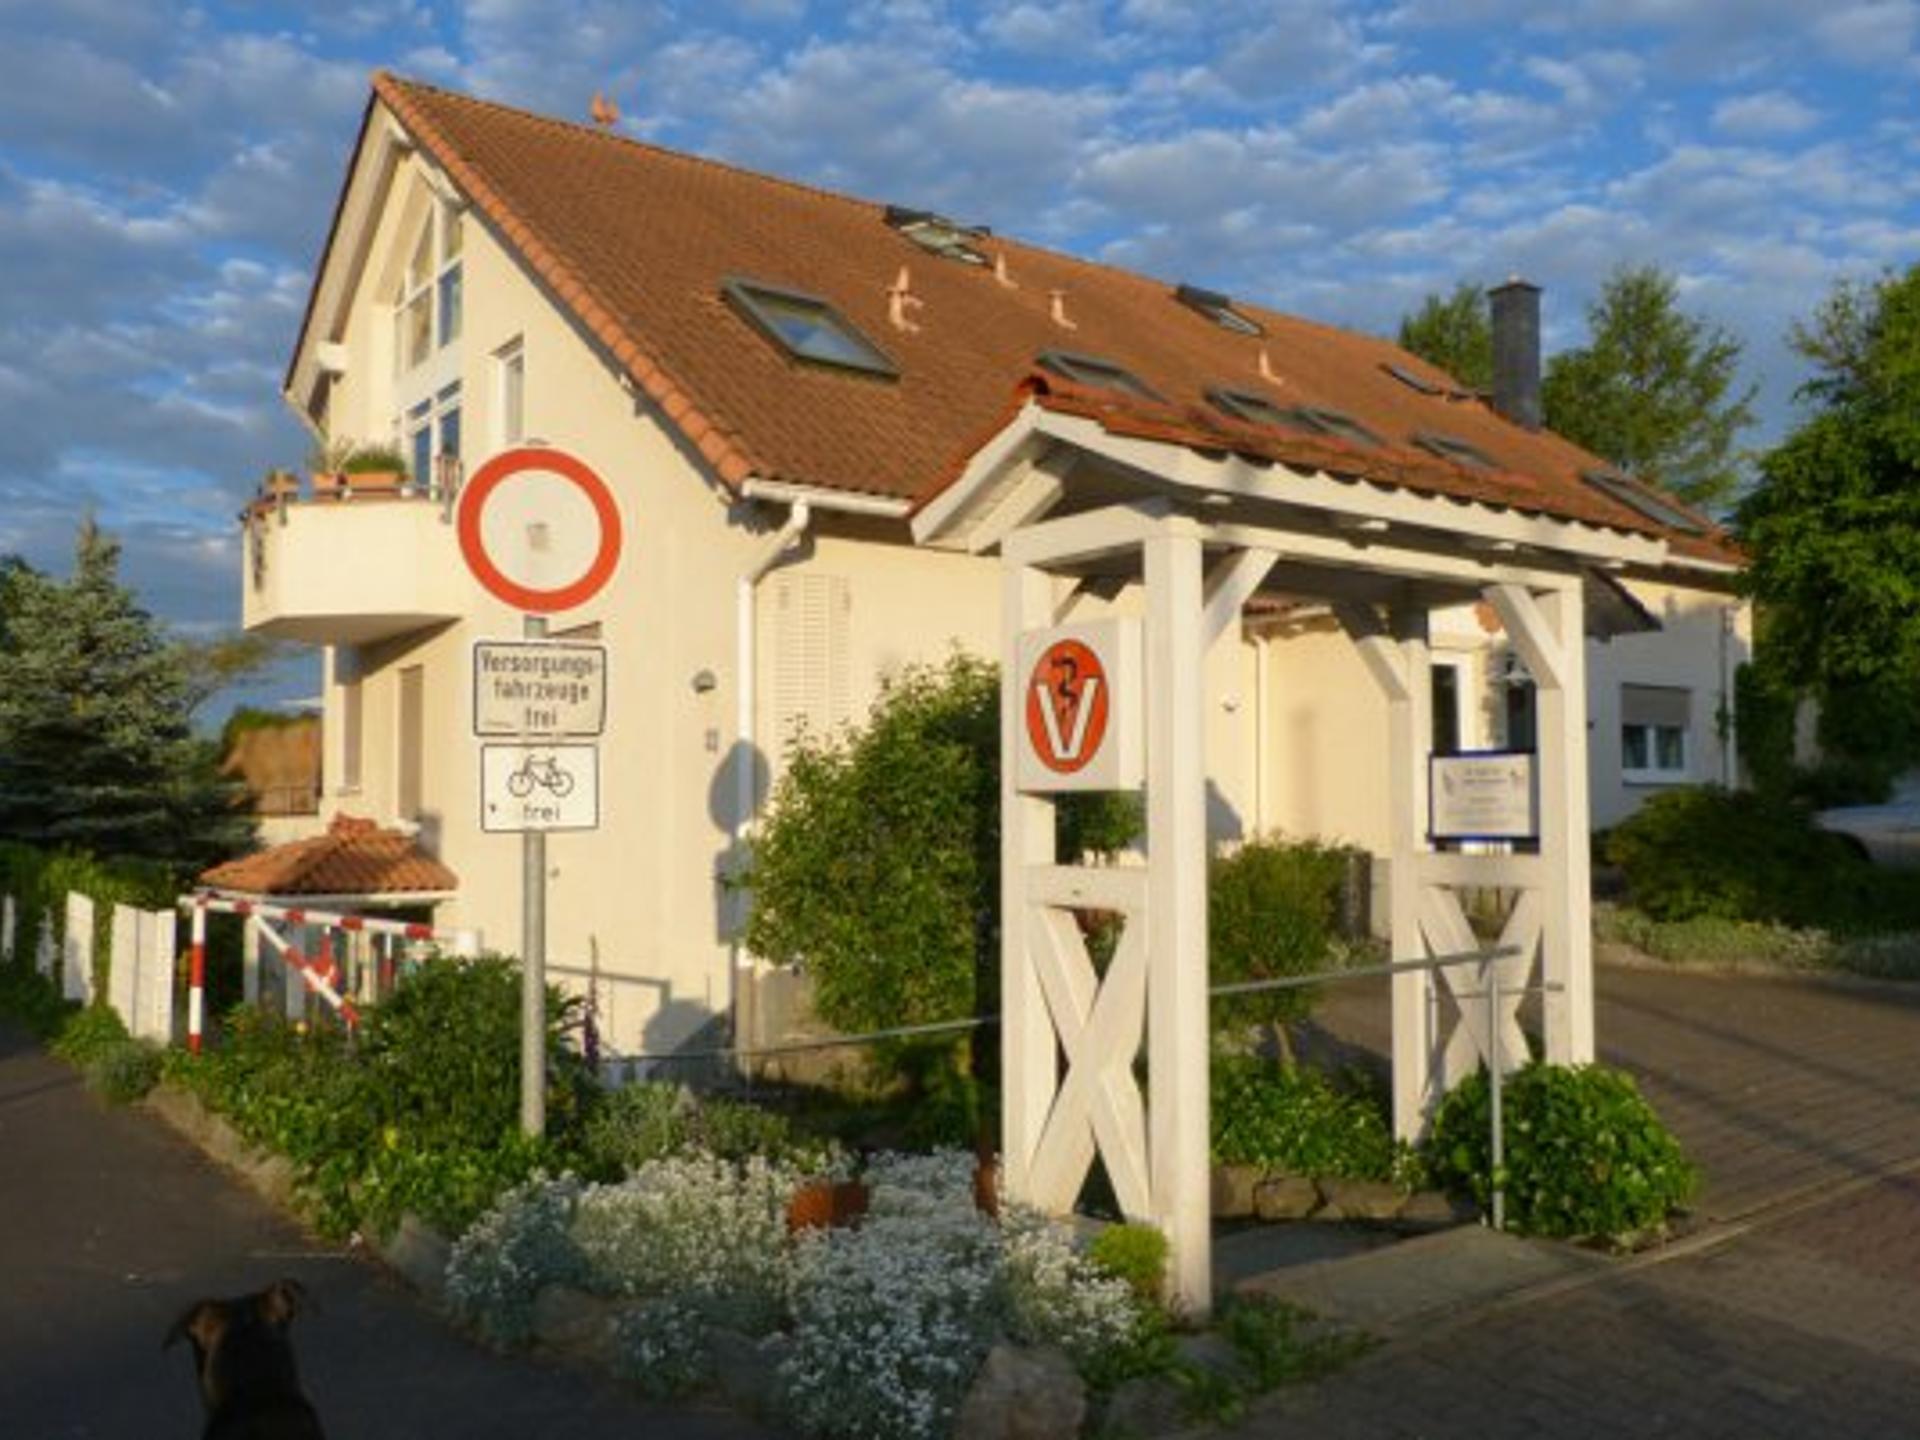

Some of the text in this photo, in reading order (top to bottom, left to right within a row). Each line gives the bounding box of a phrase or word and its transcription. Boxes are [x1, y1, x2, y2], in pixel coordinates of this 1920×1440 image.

[494, 679, 589, 705] fahrzeuge
[526, 707, 557, 727] frei
[1037, 678, 1100, 759] V
[523, 803, 560, 821] frei
